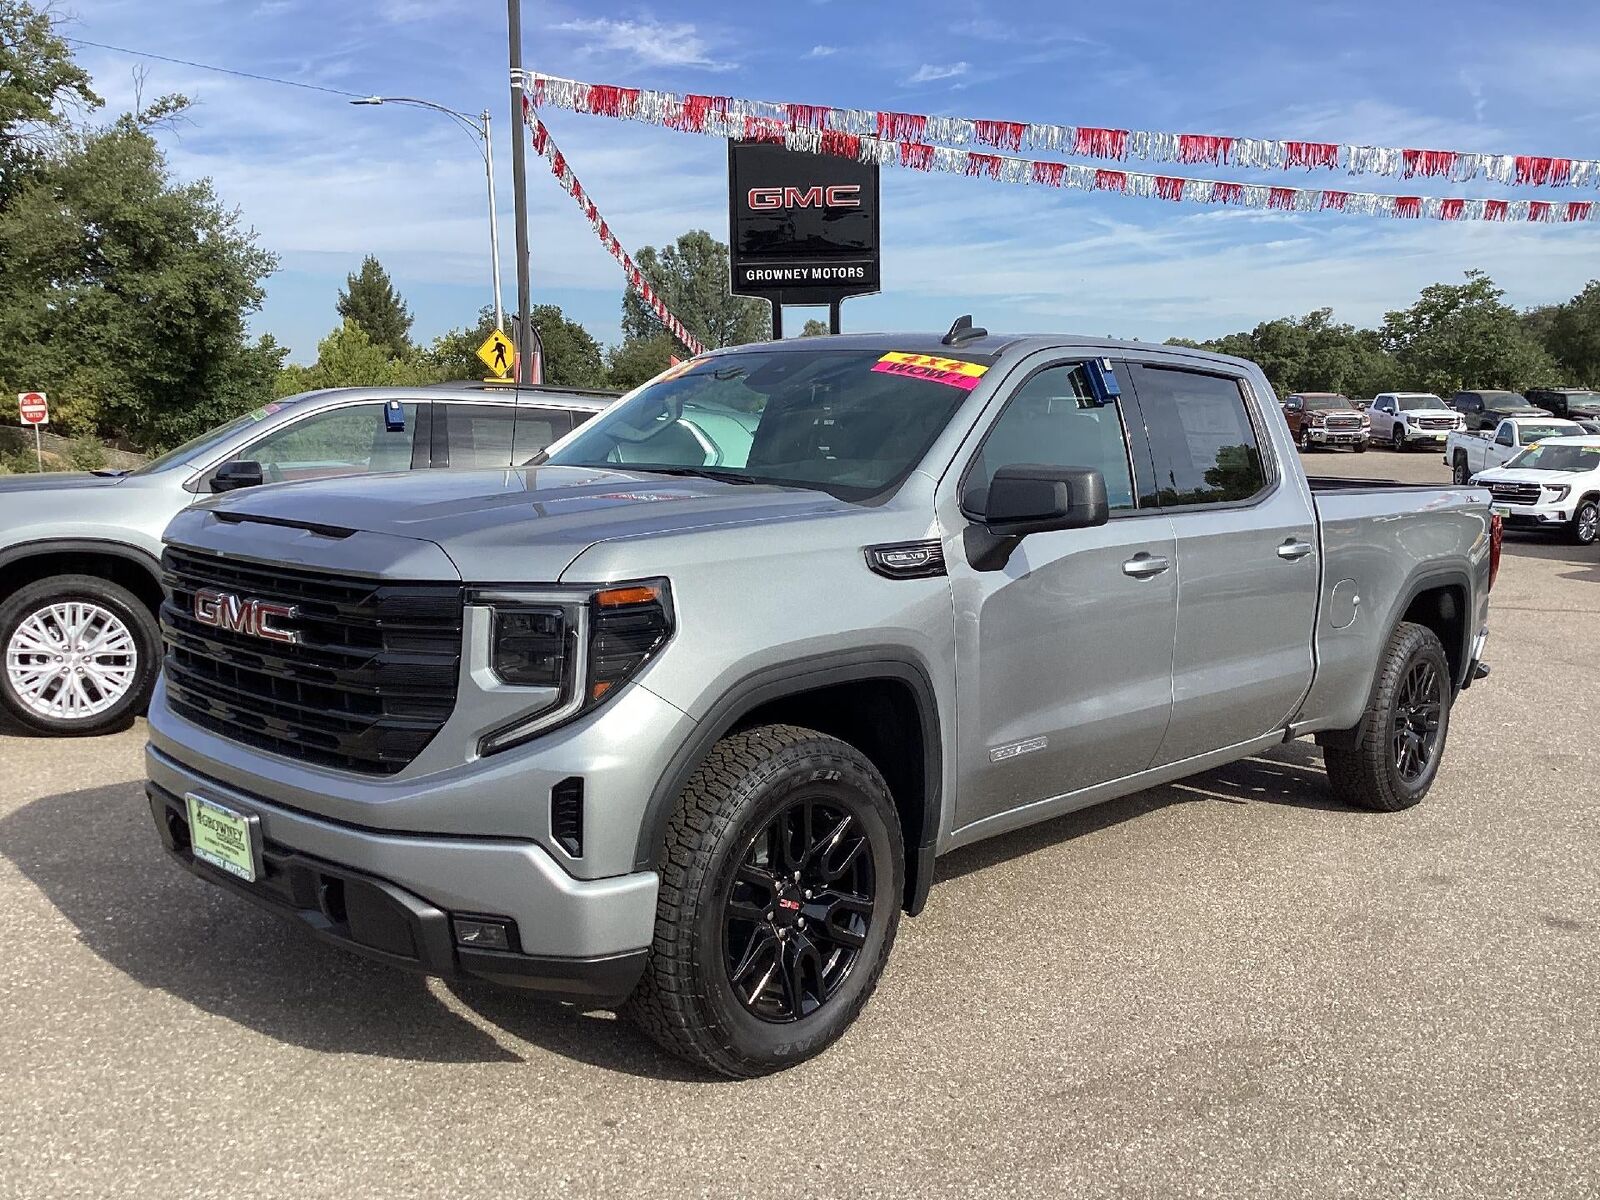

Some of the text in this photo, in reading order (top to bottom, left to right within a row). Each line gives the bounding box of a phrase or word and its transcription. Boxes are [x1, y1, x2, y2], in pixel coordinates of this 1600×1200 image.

[748, 185, 861, 210] GMC
[746, 267, 864, 281] GROWNEY MOTORS
[194, 588, 302, 644] GMC
[201, 814, 243, 842] GROWNEY
